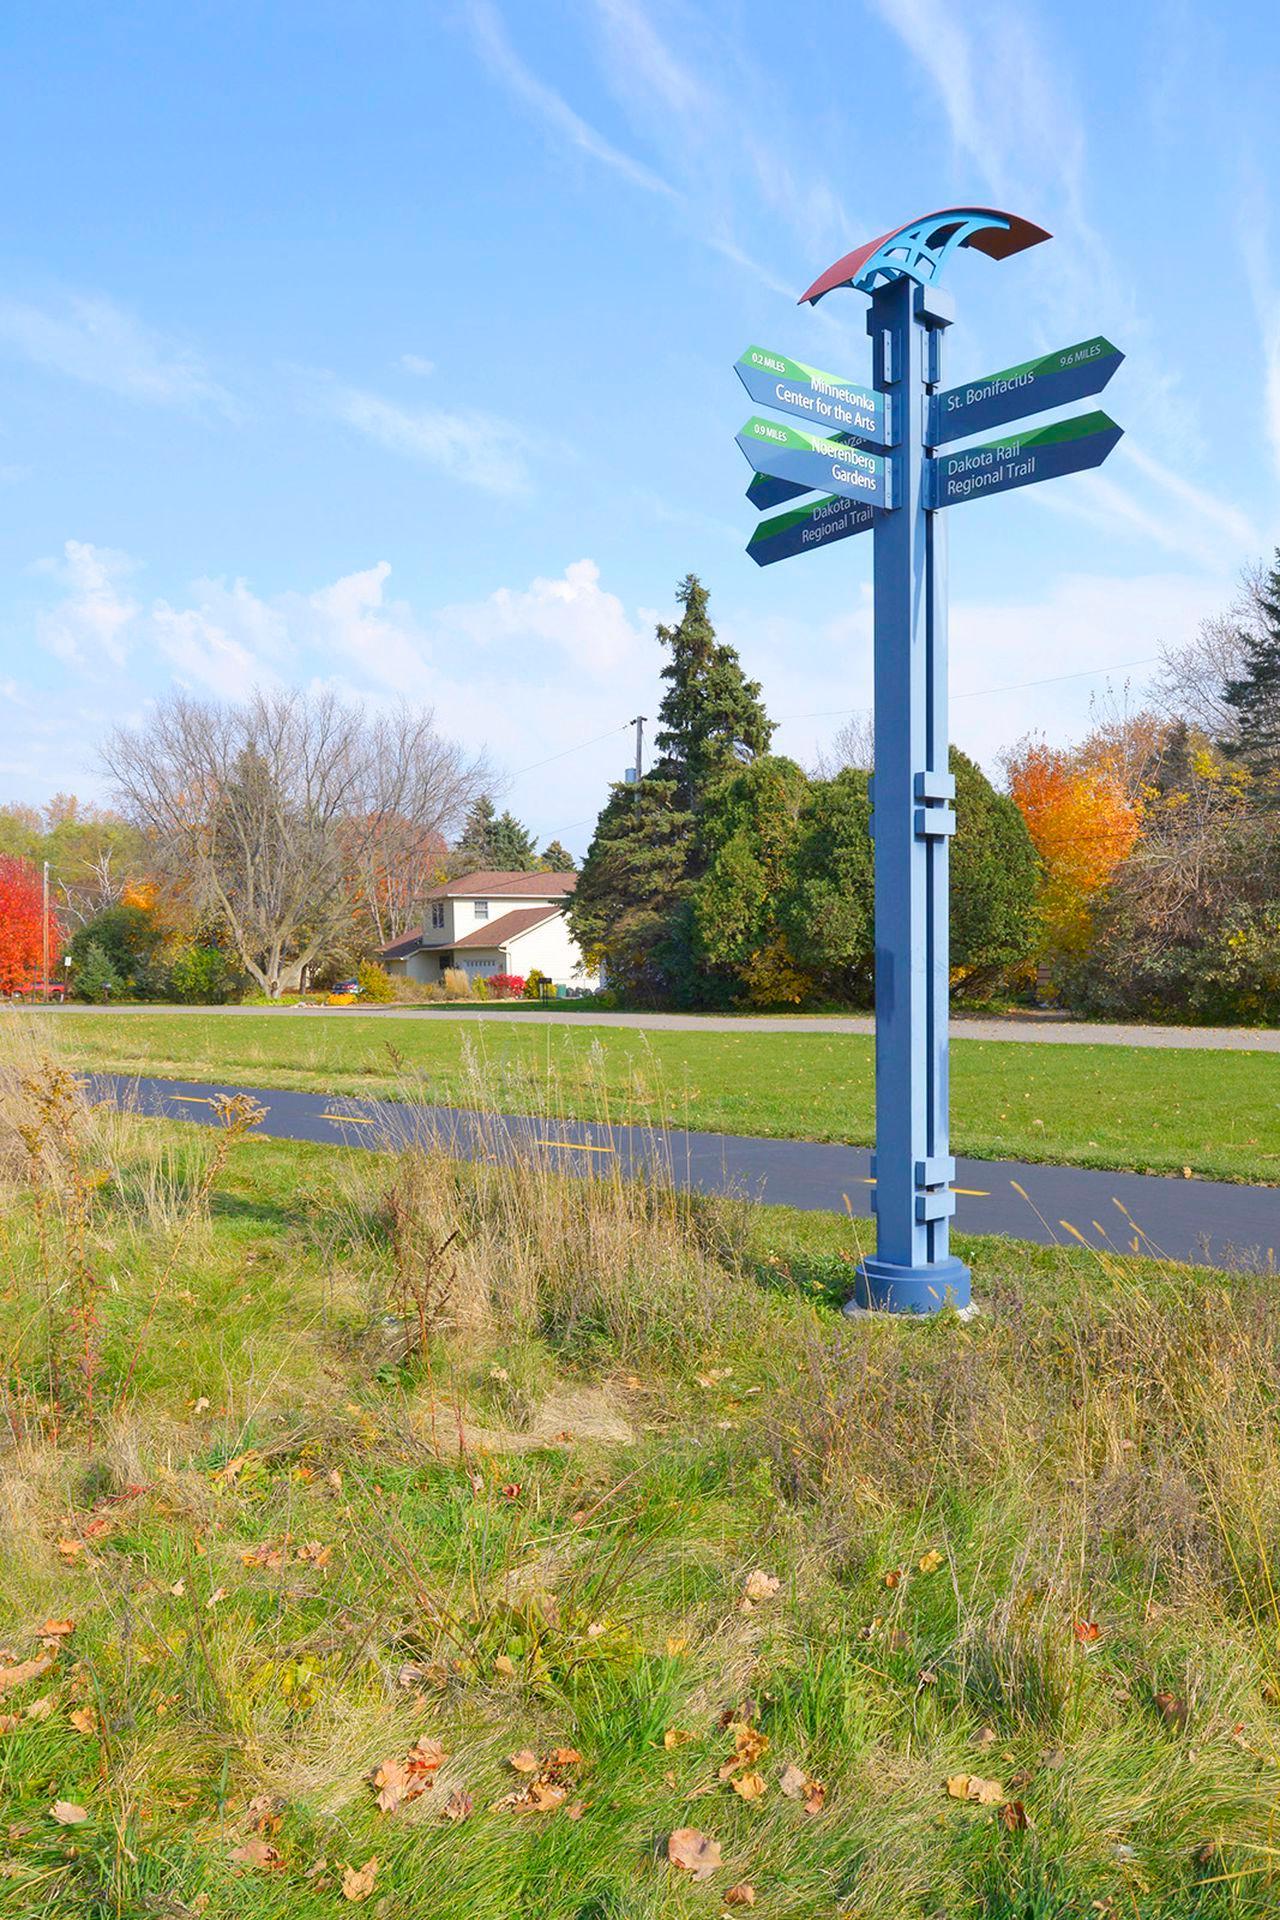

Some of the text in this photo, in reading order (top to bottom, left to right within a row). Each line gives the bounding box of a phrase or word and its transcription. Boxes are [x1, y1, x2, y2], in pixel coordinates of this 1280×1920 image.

[752, 352, 785, 373] 0.2 MILES
[1060, 344, 1101, 367] 9.6 MILES
[775, 383, 876, 432] Center for the Arts
[811, 375, 875, 412] Minnetonka
[948, 371, 1035, 412] St. Bonifacius
[754, 424, 788, 442] 0.9 MILES
[811, 437, 876, 474] Noerenberg
[948, 440, 1020, 476] Dakota Rail
[832, 464, 877, 490] Gardens
[947, 457, 1035, 496] Regional Trail
[801, 505, 873, 543] Regional Trail
[812, 498, 851, 521] Dakota
